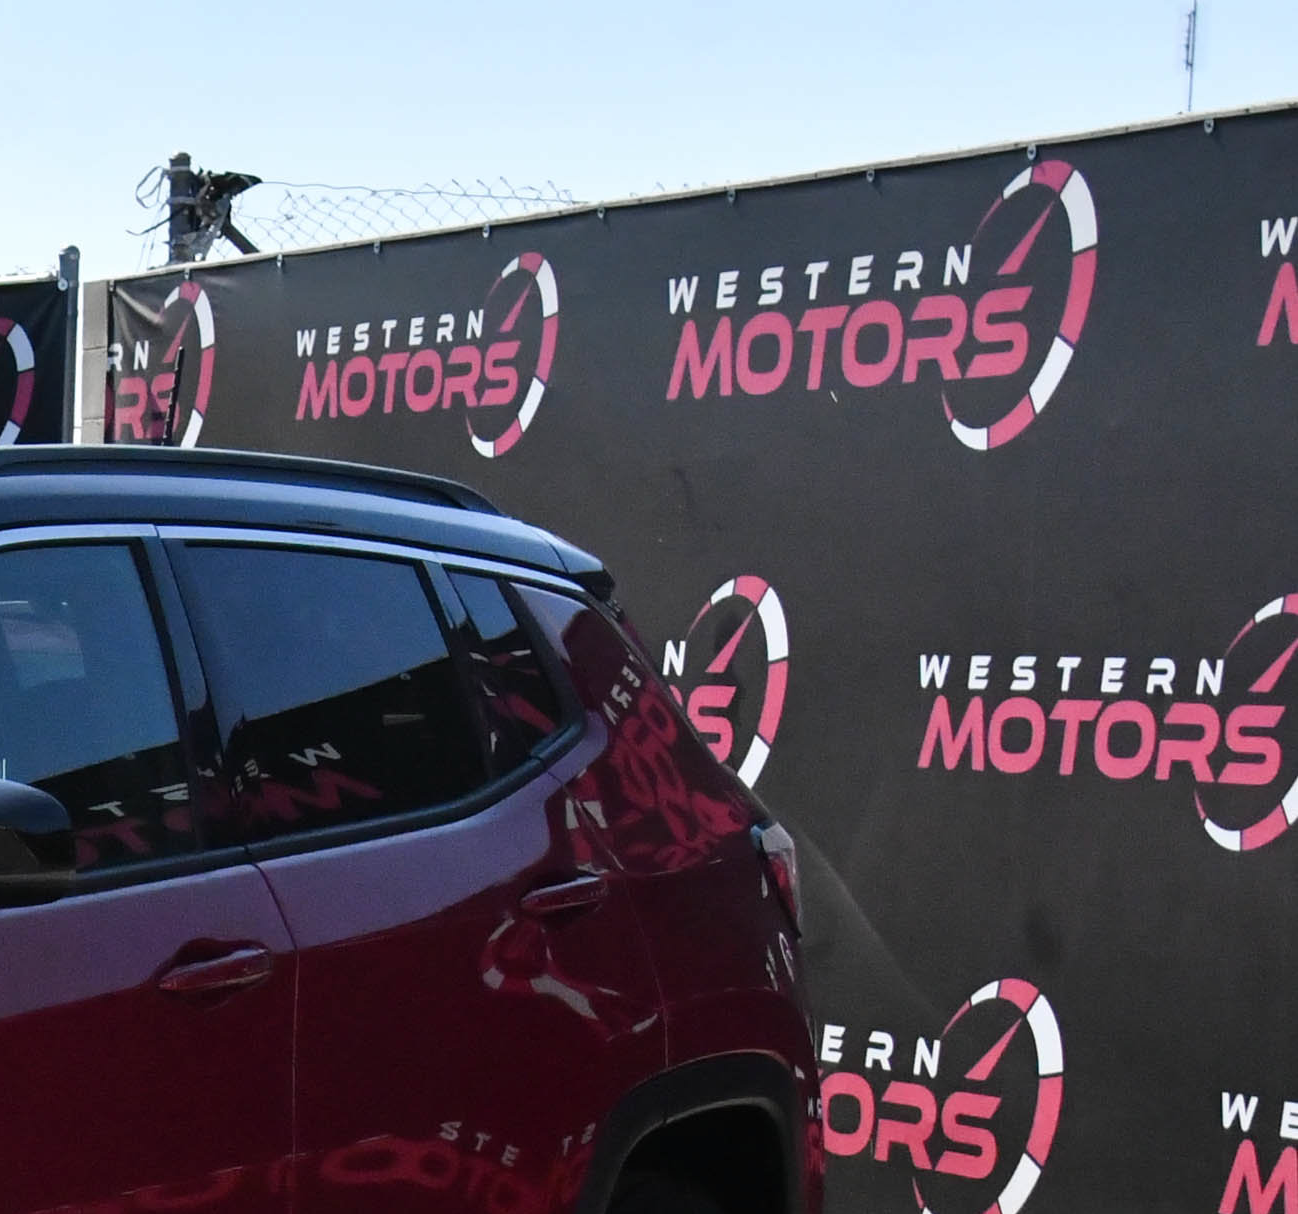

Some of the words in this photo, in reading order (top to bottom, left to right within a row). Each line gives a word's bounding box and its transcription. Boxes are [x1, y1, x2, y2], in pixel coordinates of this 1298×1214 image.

[668, 243, 973, 315] WESTERN
[296, 308, 485, 358] WESTERN
[666, 285, 1034, 402] MOTORS
[295, 339, 522, 421] MOTORS
[918, 653, 1225, 697] WESTERN
[917, 695, 1286, 786] MOTORS
